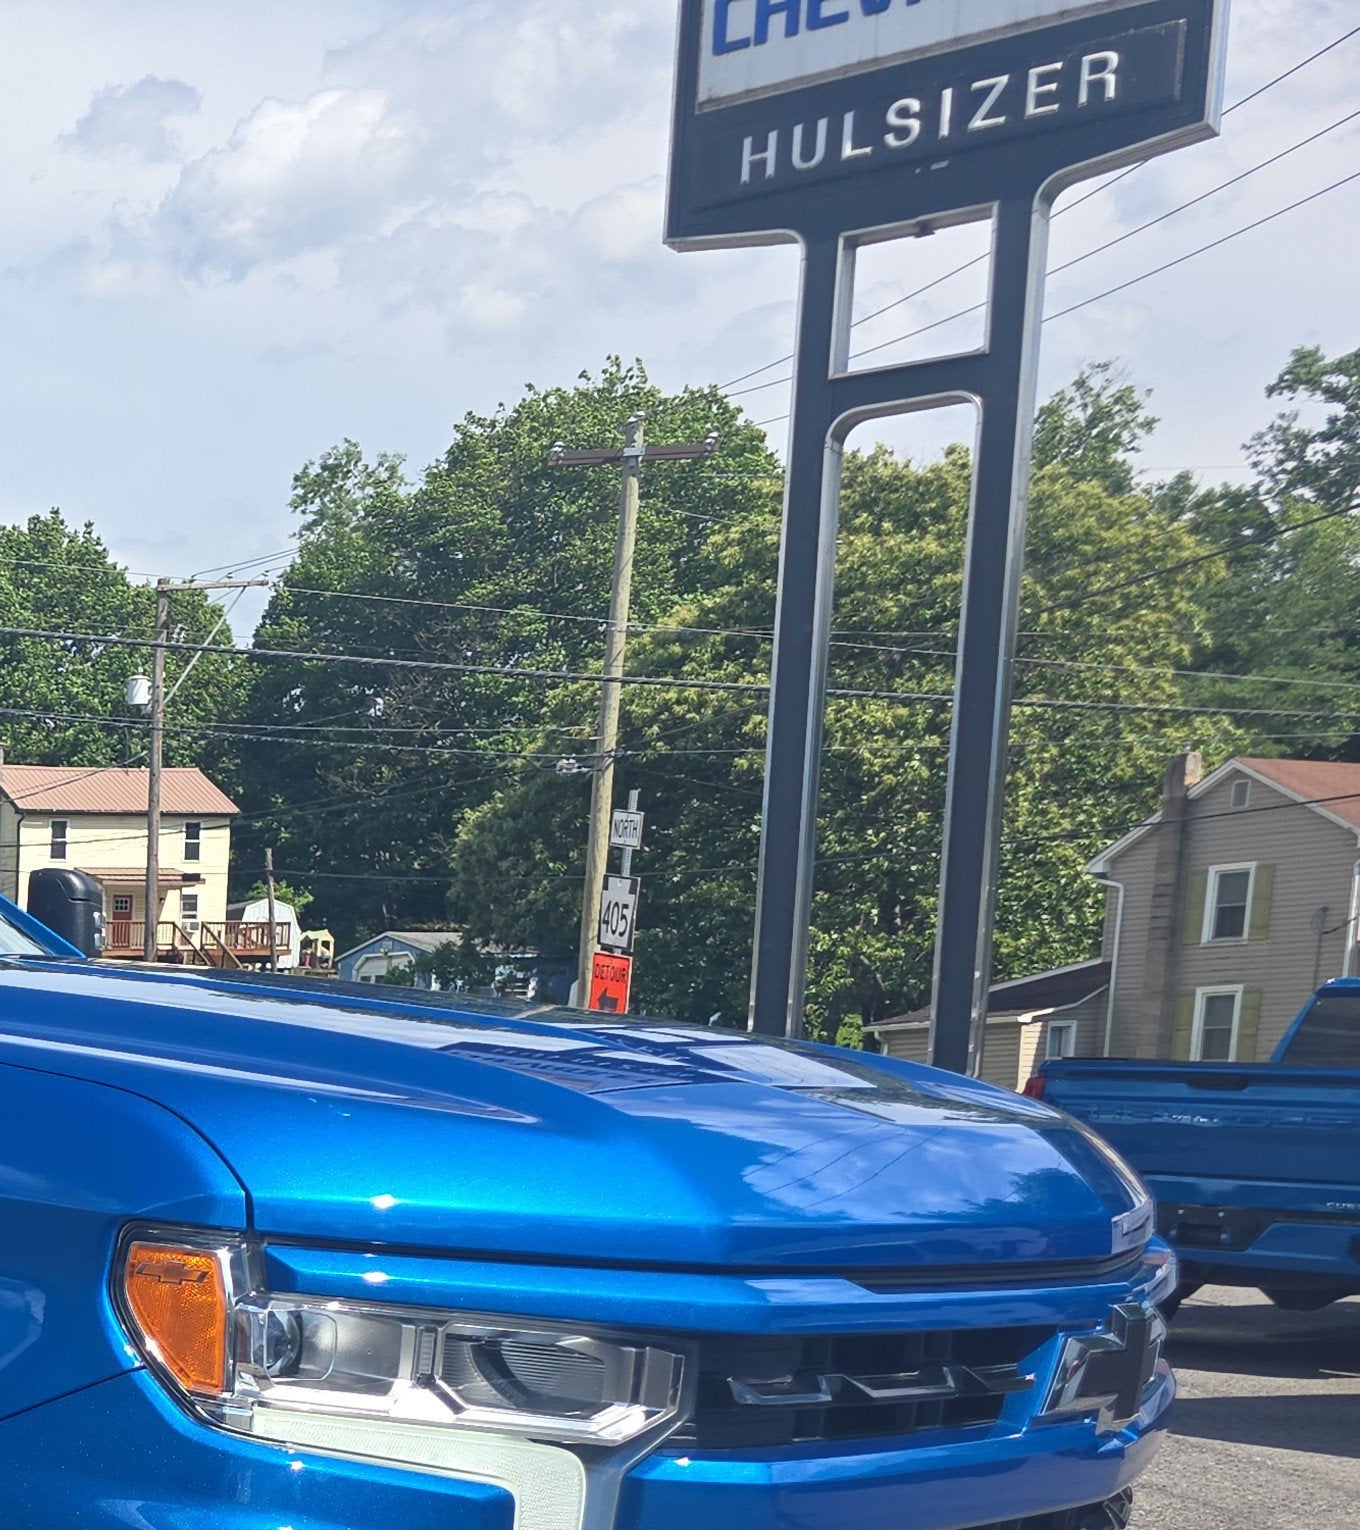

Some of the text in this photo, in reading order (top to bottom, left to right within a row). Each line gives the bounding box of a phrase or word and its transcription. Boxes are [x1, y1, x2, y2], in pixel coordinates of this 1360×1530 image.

[739, 50, 1120, 185] HULSIZER
[613, 819, 638, 838] NORTH
[602, 901, 629, 937] 405
[594, 964, 626, 982] DETOUR
